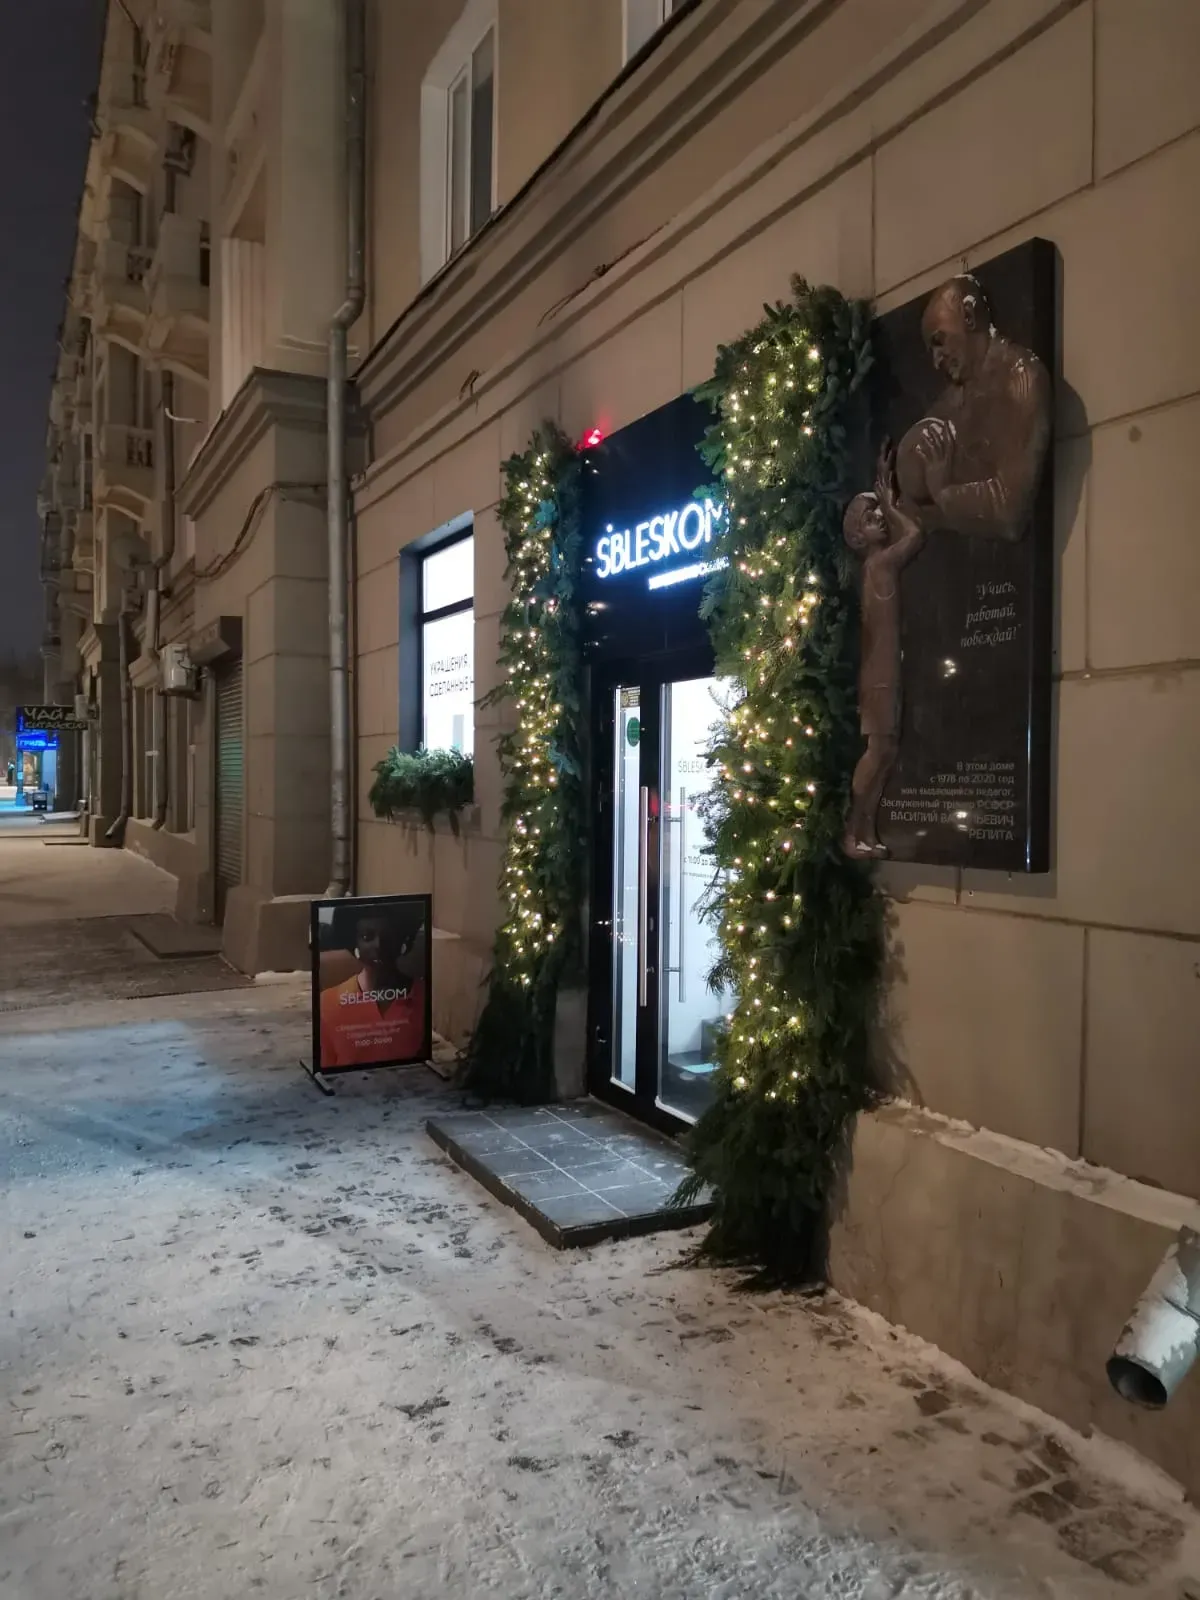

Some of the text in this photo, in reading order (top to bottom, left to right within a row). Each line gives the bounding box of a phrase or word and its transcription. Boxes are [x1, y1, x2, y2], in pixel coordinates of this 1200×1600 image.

[24, 707, 63, 720] ЧАЙ
[957, 762, 963, 771] В
[989, 762, 1015, 771] доме
[880, 798, 940, 809] Заслуженный
[890, 810, 938, 823] ВАСИЛИЙ
[969, 828, 1014, 841] РЕПИТА
